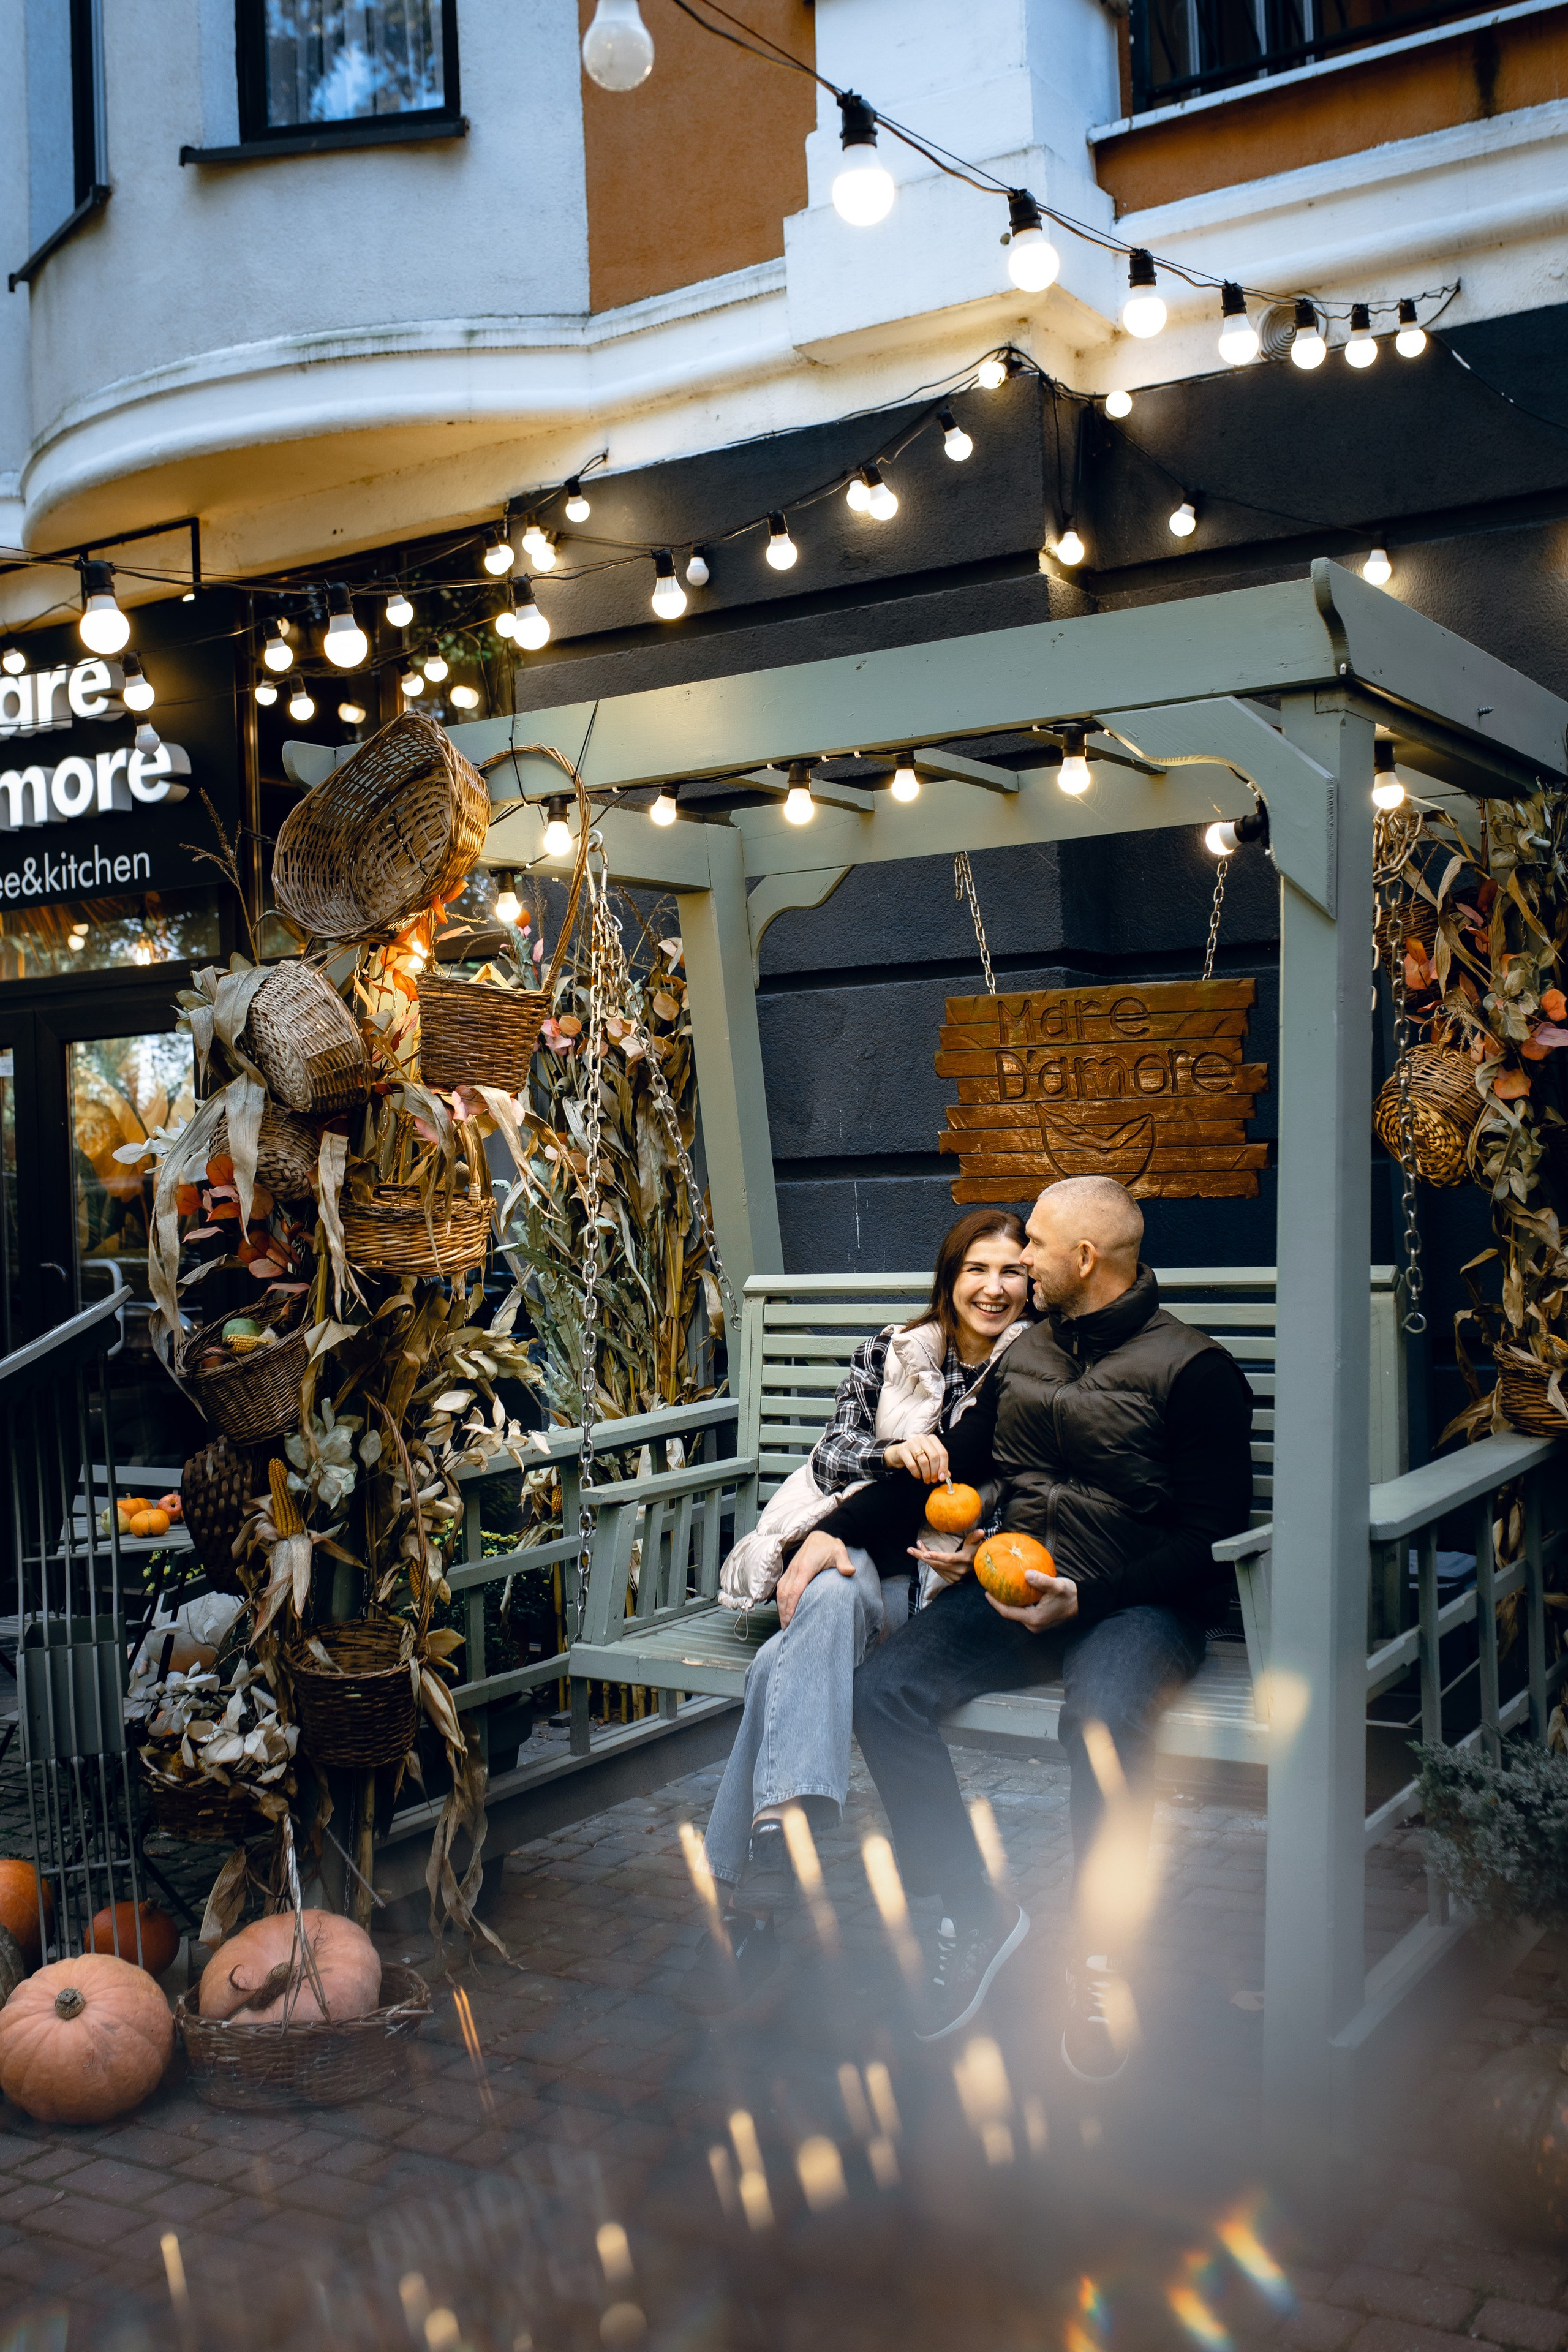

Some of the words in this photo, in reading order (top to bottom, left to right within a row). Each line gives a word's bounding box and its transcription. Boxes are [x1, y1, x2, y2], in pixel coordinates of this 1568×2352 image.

[0, 844, 151, 899] e&kitchen
[997, 997, 1150, 1047] Mare
[995, 1048, 1237, 1101] D'amore
